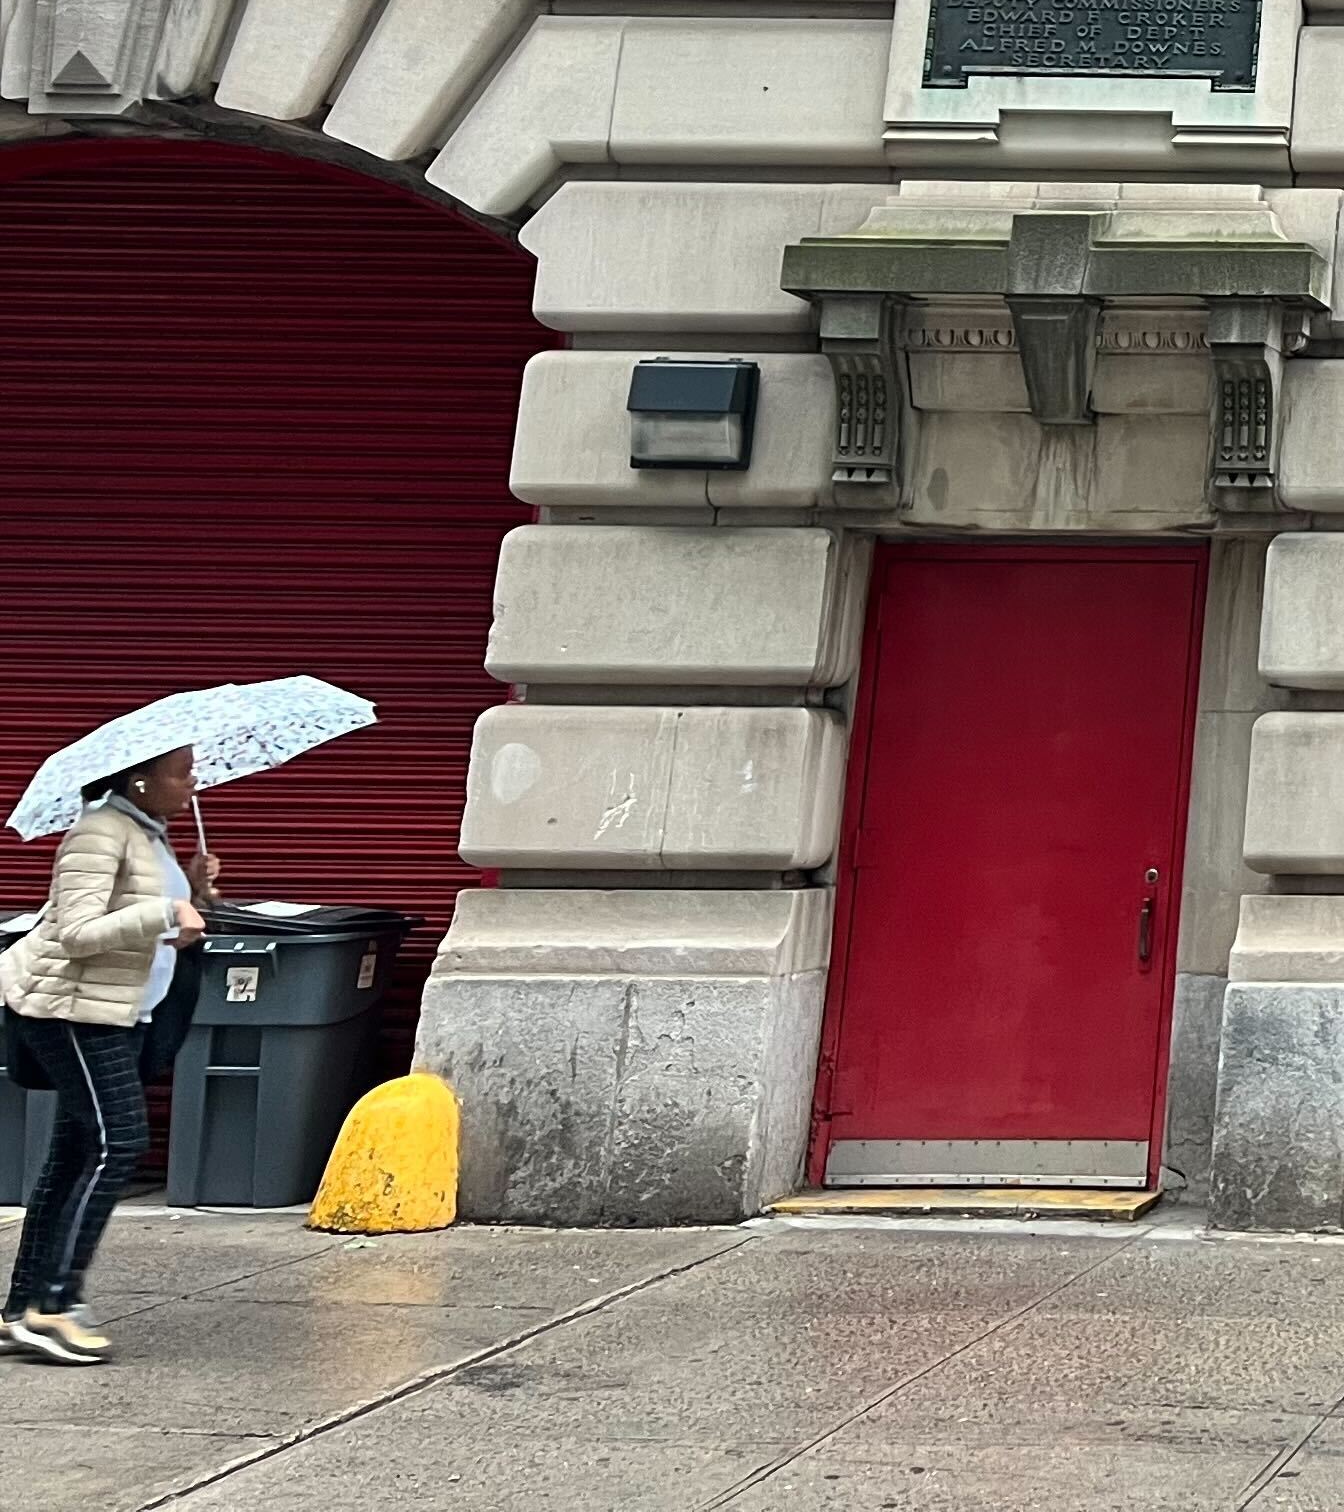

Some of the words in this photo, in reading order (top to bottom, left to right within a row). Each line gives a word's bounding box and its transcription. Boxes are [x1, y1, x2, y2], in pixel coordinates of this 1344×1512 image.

[967, 9, 1074, 24] EDWARD
[983, 23, 1057, 38] CHIEF
[1076, 25, 1103, 39] OF
[959, 38, 1066, 53] ALFRED
[1011, 53, 1170, 69] SECRETARY
